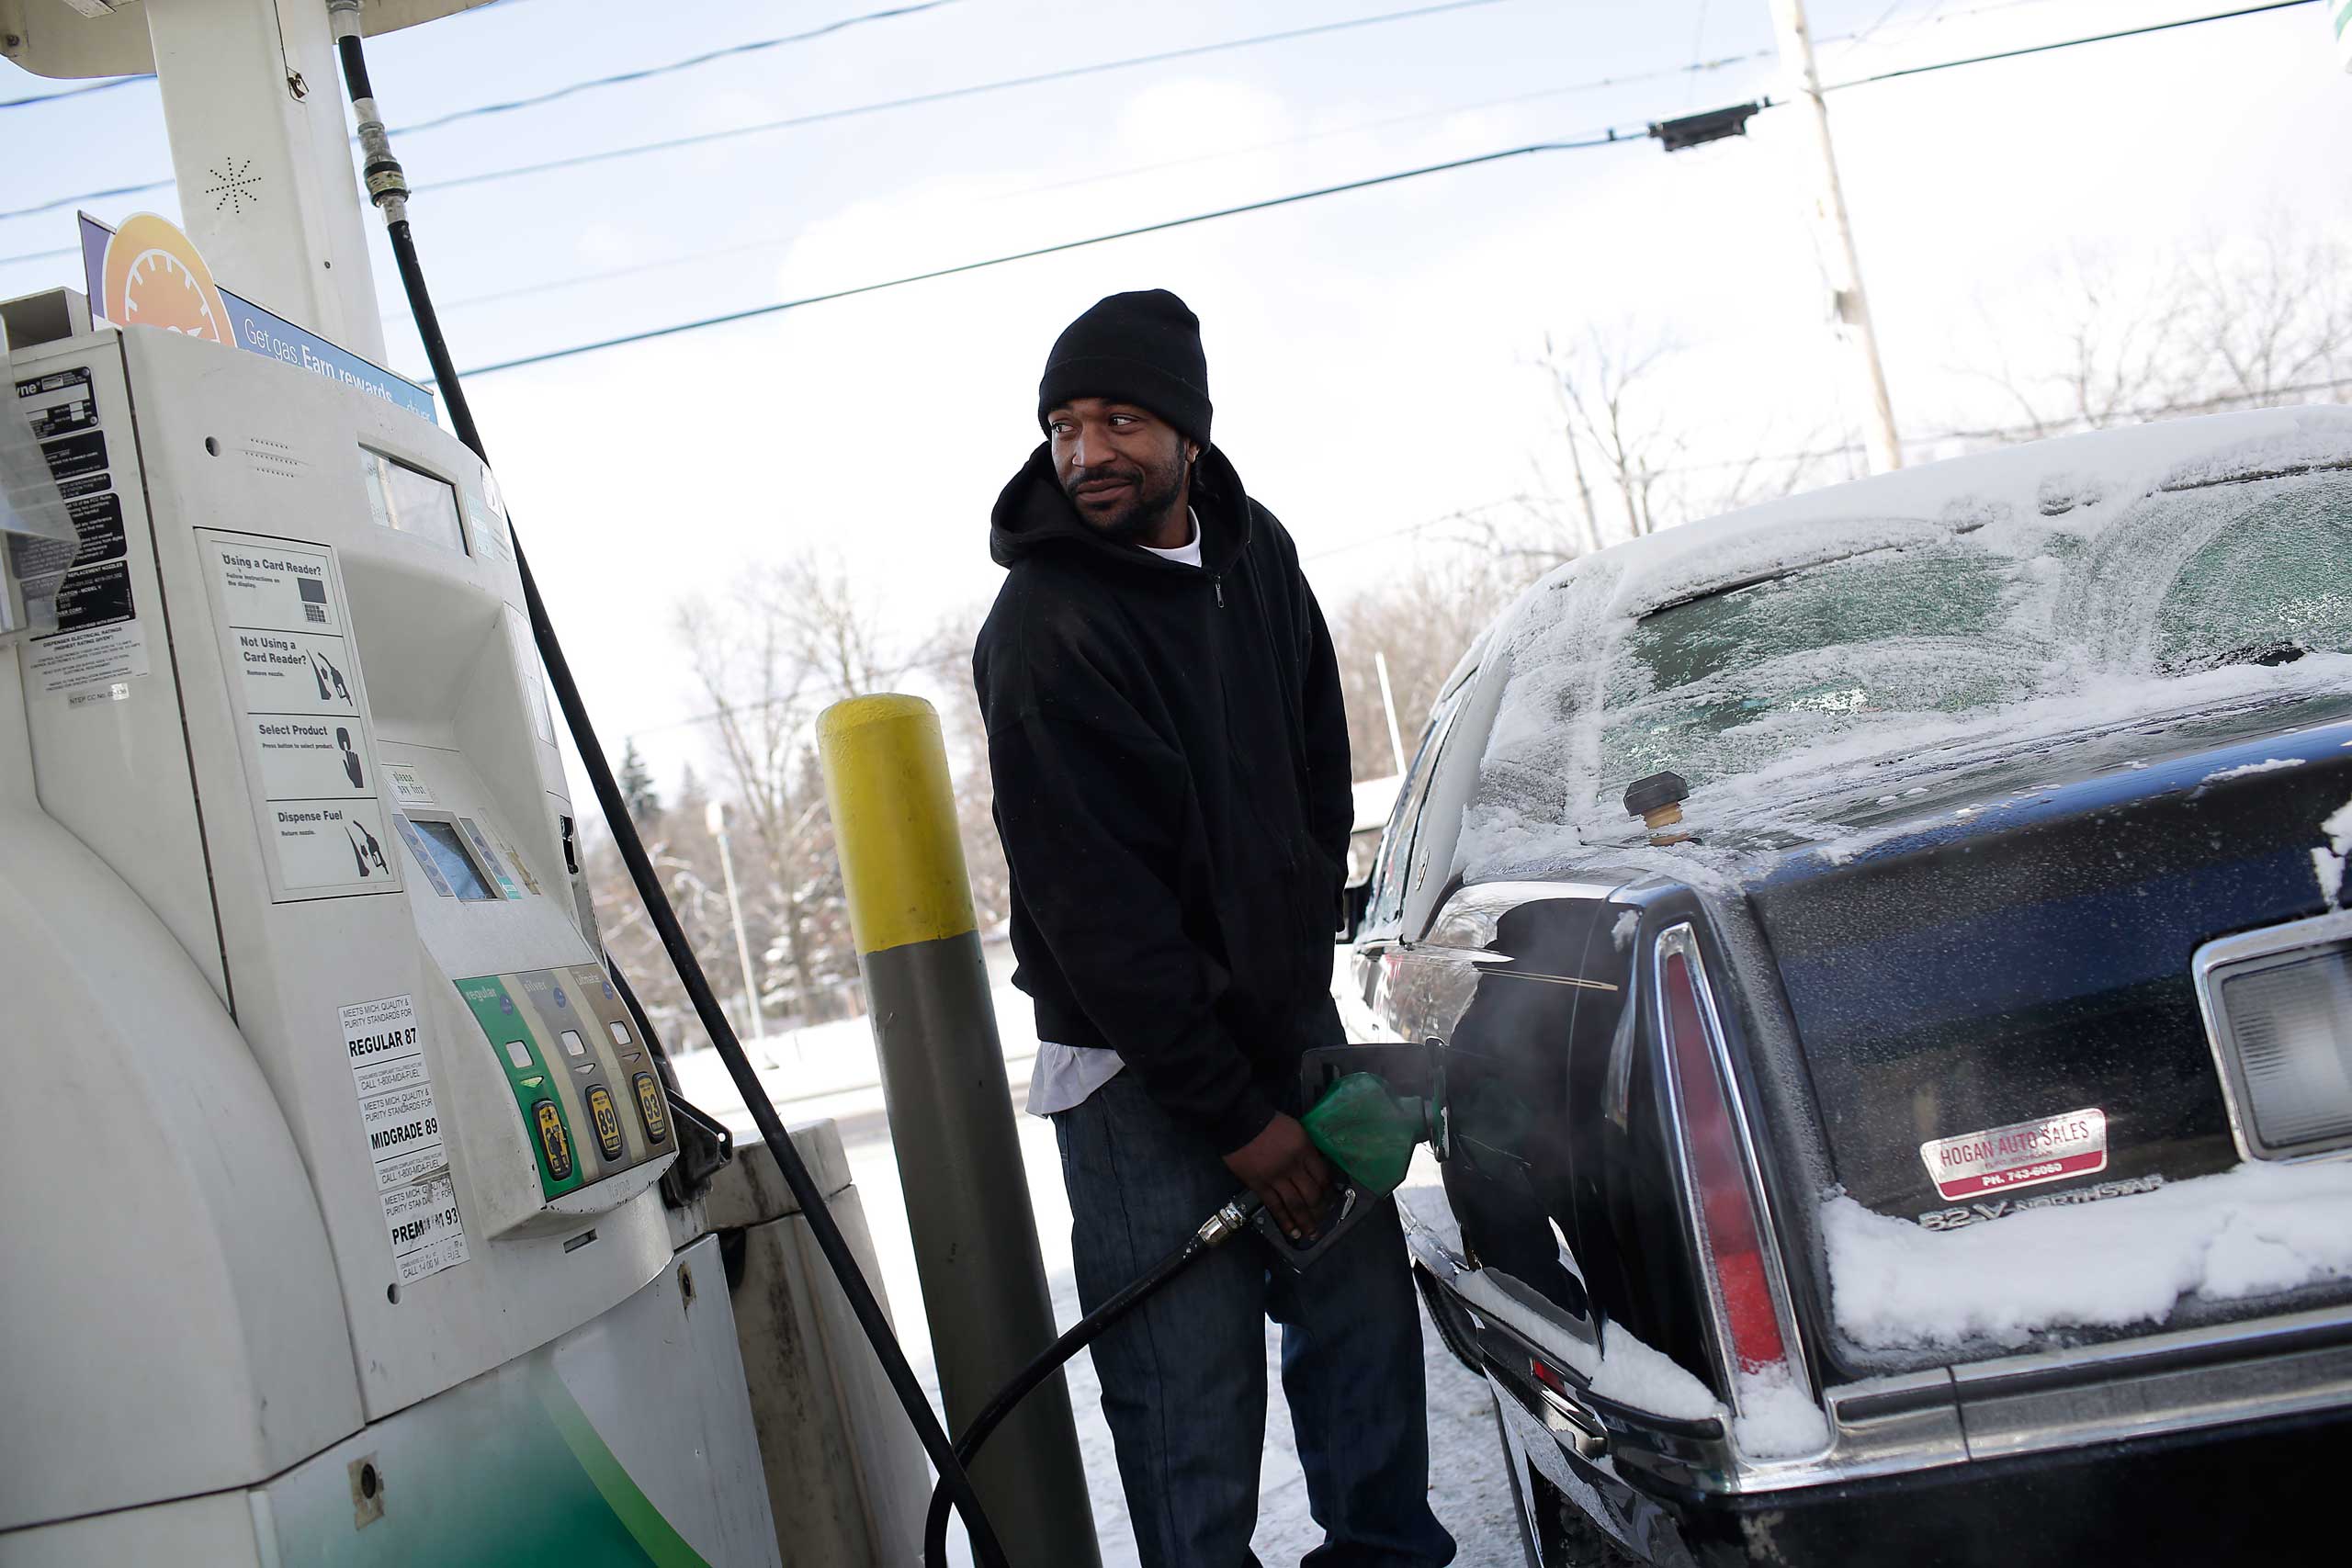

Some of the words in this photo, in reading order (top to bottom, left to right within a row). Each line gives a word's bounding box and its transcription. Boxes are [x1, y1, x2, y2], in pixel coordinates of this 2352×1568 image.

[244, 318, 272, 353] Get
[274, 338, 301, 366] gas.
[301, 344, 335, 378] Earn
[223, 554, 252, 569] Using
[254, 559, 260, 568] a
[263, 558, 284, 571] Card
[286, 562, 322, 576] Reader?
[244, 574, 273, 583] instructions
[240, 636, 259, 647] Not
[261, 637, 288, 650] Using
[290, 641, 297, 649] a
[243, 651, 267, 662] Card
[269, 653, 307, 665] Reader?
[259, 724, 293, 735] Select
[292, 725, 328, 736] Product
[277, 812, 322, 823] Dispense
[323, 810, 343, 820] Fuel
[466, 987, 497, 1002] regular
[525, 979, 548, 993] silver
[343, 1007, 364, 1018] MEETS
[380, 999, 404, 1010] QUALITY
[344, 1019, 366, 1029] PURITY
[367, 1010, 401, 1025] STANDARDS
[401, 1008, 413, 1017] FOR
[348, 1031, 403, 1057] REGULAR
[404, 1027, 416, 1045] 87
[361, 1079, 376, 1090] CALL
[364, 1100, 385, 1111] MEETS
[401, 1090, 424, 1102] QUALITY
[366, 1111, 387, 1122] PURITY
[388, 1102, 421, 1117] STANDARDS
[421, 1098, 433, 1108] FOR
[643, 1094, 661, 1120] 93
[597, 1108, 616, 1136] 89
[371, 1122, 424, 1150] MIDGRADE
[425, 1117, 438, 1135] 89
[1940, 1142, 1995, 1167] HOGAN
[1998, 1131, 2038, 1155] AUTO
[2042, 1121, 2089, 1146] SALES
[382, 1173, 397, 1184] CALL
[1982, 1173, 2005, 1186] PH.
[385, 1193, 405, 1205] MEETS
[387, 1204, 407, 1216] PURITY
[441, 1189, 453, 1199] FOR
[446, 1207, 458, 1226] 93
[403, 1265, 418, 1279] CALL
